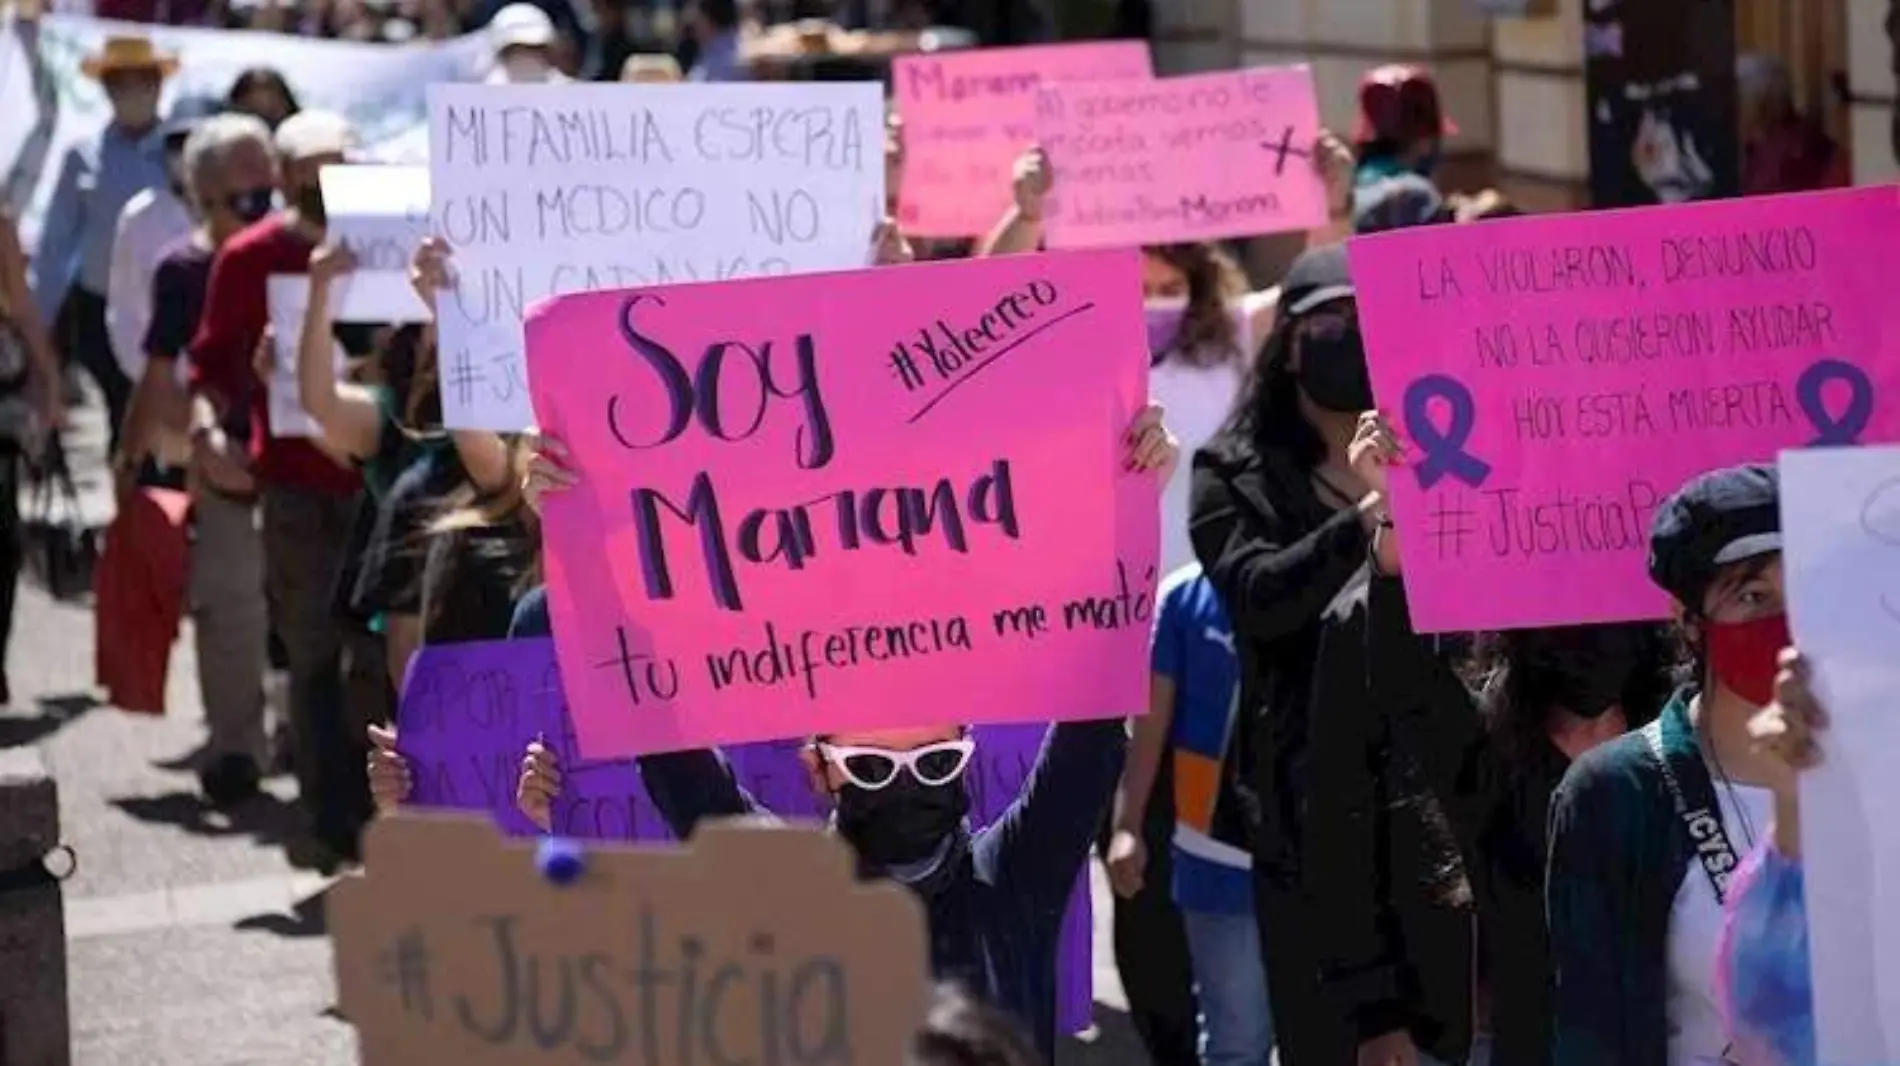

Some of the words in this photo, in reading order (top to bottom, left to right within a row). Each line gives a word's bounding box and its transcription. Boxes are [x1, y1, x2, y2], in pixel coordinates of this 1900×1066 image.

[446, 106, 487, 167] MI
[501, 105, 673, 167] FAMILIA
[693, 106, 864, 172] ESPERA
[442, 196, 510, 246] UN
[537, 184, 705, 240] MEDICO
[748, 189, 820, 245] NO
[453, 267, 525, 326] UN
[1418, 258, 1462, 300] LA
[1475, 324, 1518, 368] NO
[1530, 324, 1568, 366] LA
[1729, 303, 1837, 352] AYUDAR
[607, 293, 835, 469] Soy
[1512, 394, 1566, 441] HOY
[1667, 380, 1792, 434] MUERTA
[631, 459, 1021, 613] Mariana
[1431, 477, 1664, 562] #JusticiaP
[593, 626, 680, 705] tu
[706, 613, 973, 699] indiferencia
[993, 603, 1049, 640] me
[1064, 559, 1157, 636] mató
